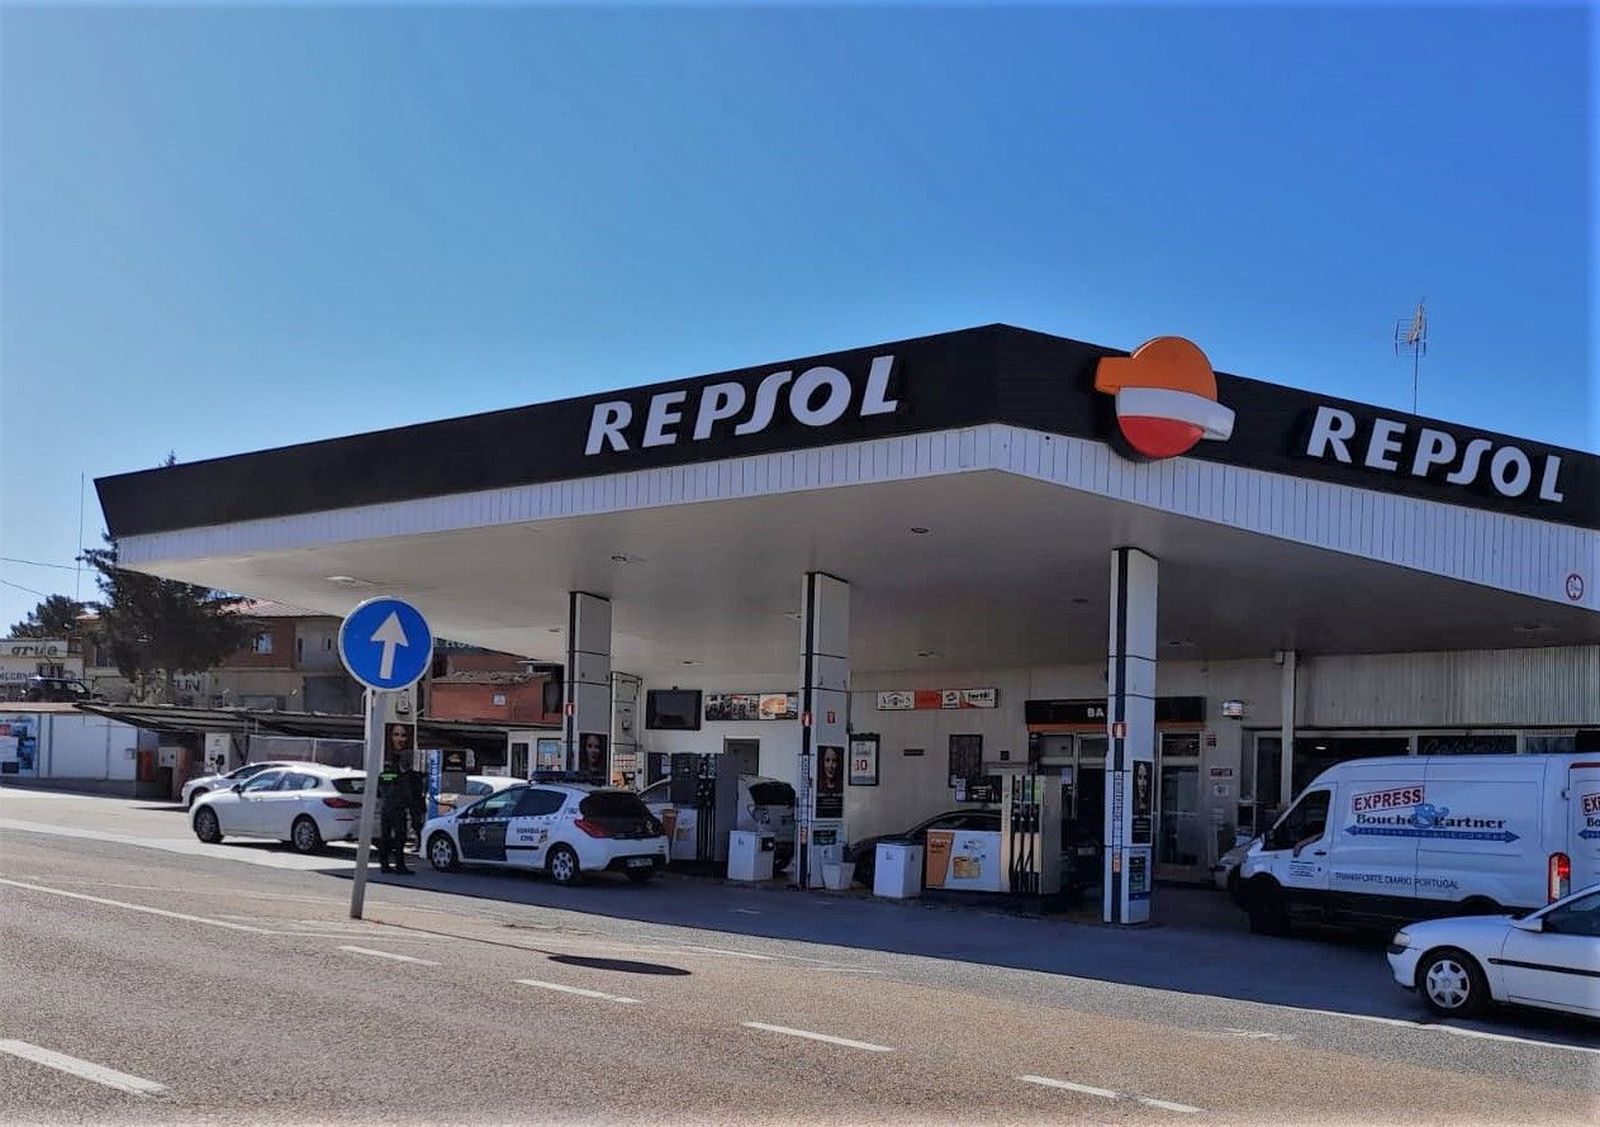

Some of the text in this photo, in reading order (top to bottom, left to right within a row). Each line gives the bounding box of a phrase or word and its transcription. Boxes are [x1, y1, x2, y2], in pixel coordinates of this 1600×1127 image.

[585, 355, 898, 455] REPSOL
[1306, 405, 1564, 502] REPSOL
[1354, 789, 1421, 811] EXPRESS
